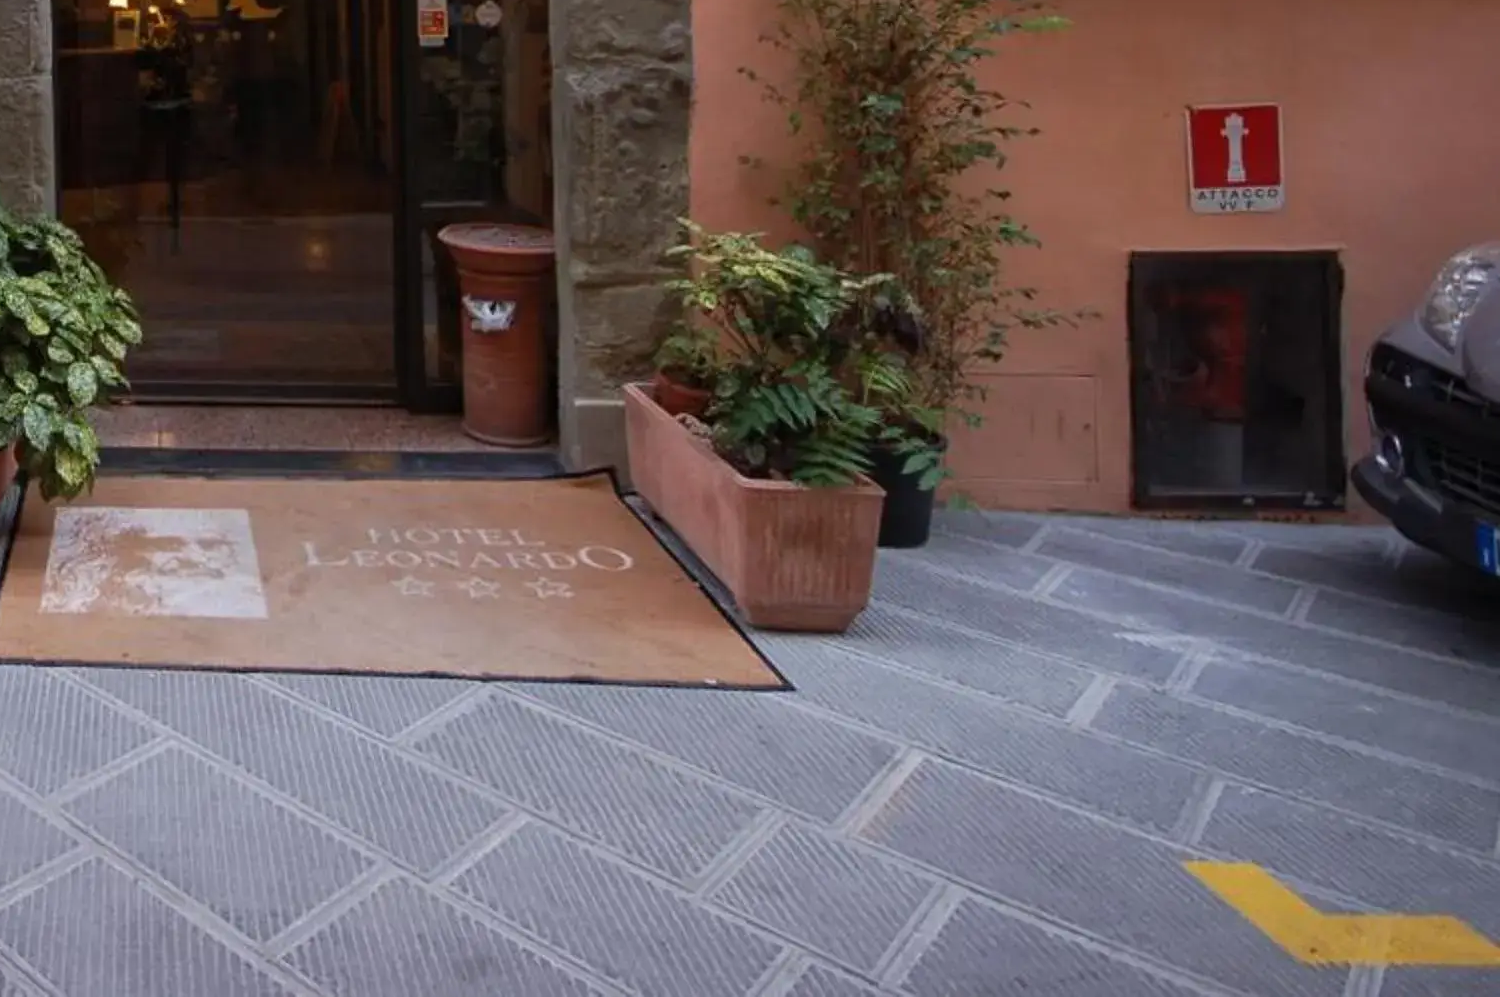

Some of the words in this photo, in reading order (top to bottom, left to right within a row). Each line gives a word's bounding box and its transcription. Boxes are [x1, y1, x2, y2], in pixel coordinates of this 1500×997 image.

[1196, 188, 1279, 200] ATTACCO
[367, 527, 546, 547] HOTEL
[301, 540, 635, 572] LEONARDO
